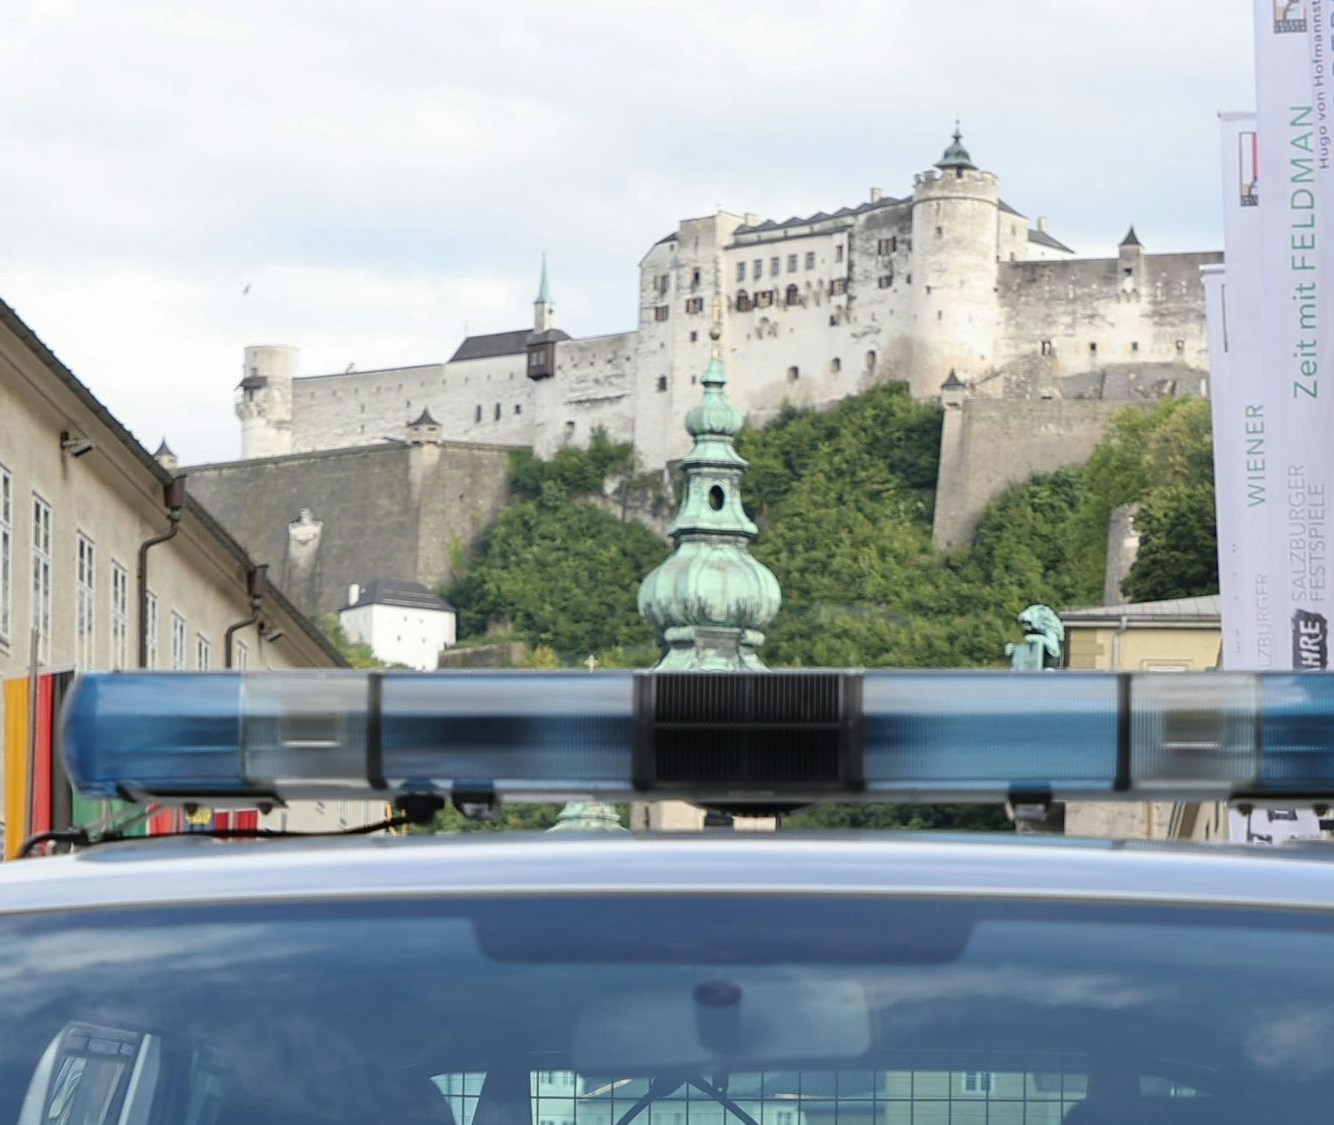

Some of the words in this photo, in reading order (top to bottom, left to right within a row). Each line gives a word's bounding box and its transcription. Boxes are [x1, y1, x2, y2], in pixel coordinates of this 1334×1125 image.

[1319, 92, 1327, 121] von
[1319, 125, 1331, 169] Hugo
[1290, 105, 1316, 271] FELDMAN
[1292, 282, 1317, 329] mit
[1293, 339, 1318, 399] Zeit
[1245, 404, 1266, 508] WIENER
[1287, 464, 1307, 602] SALZBURGER
[1307, 483, 1326, 602] FESTSPIELE
[1299, 620, 1323, 672] HRE
